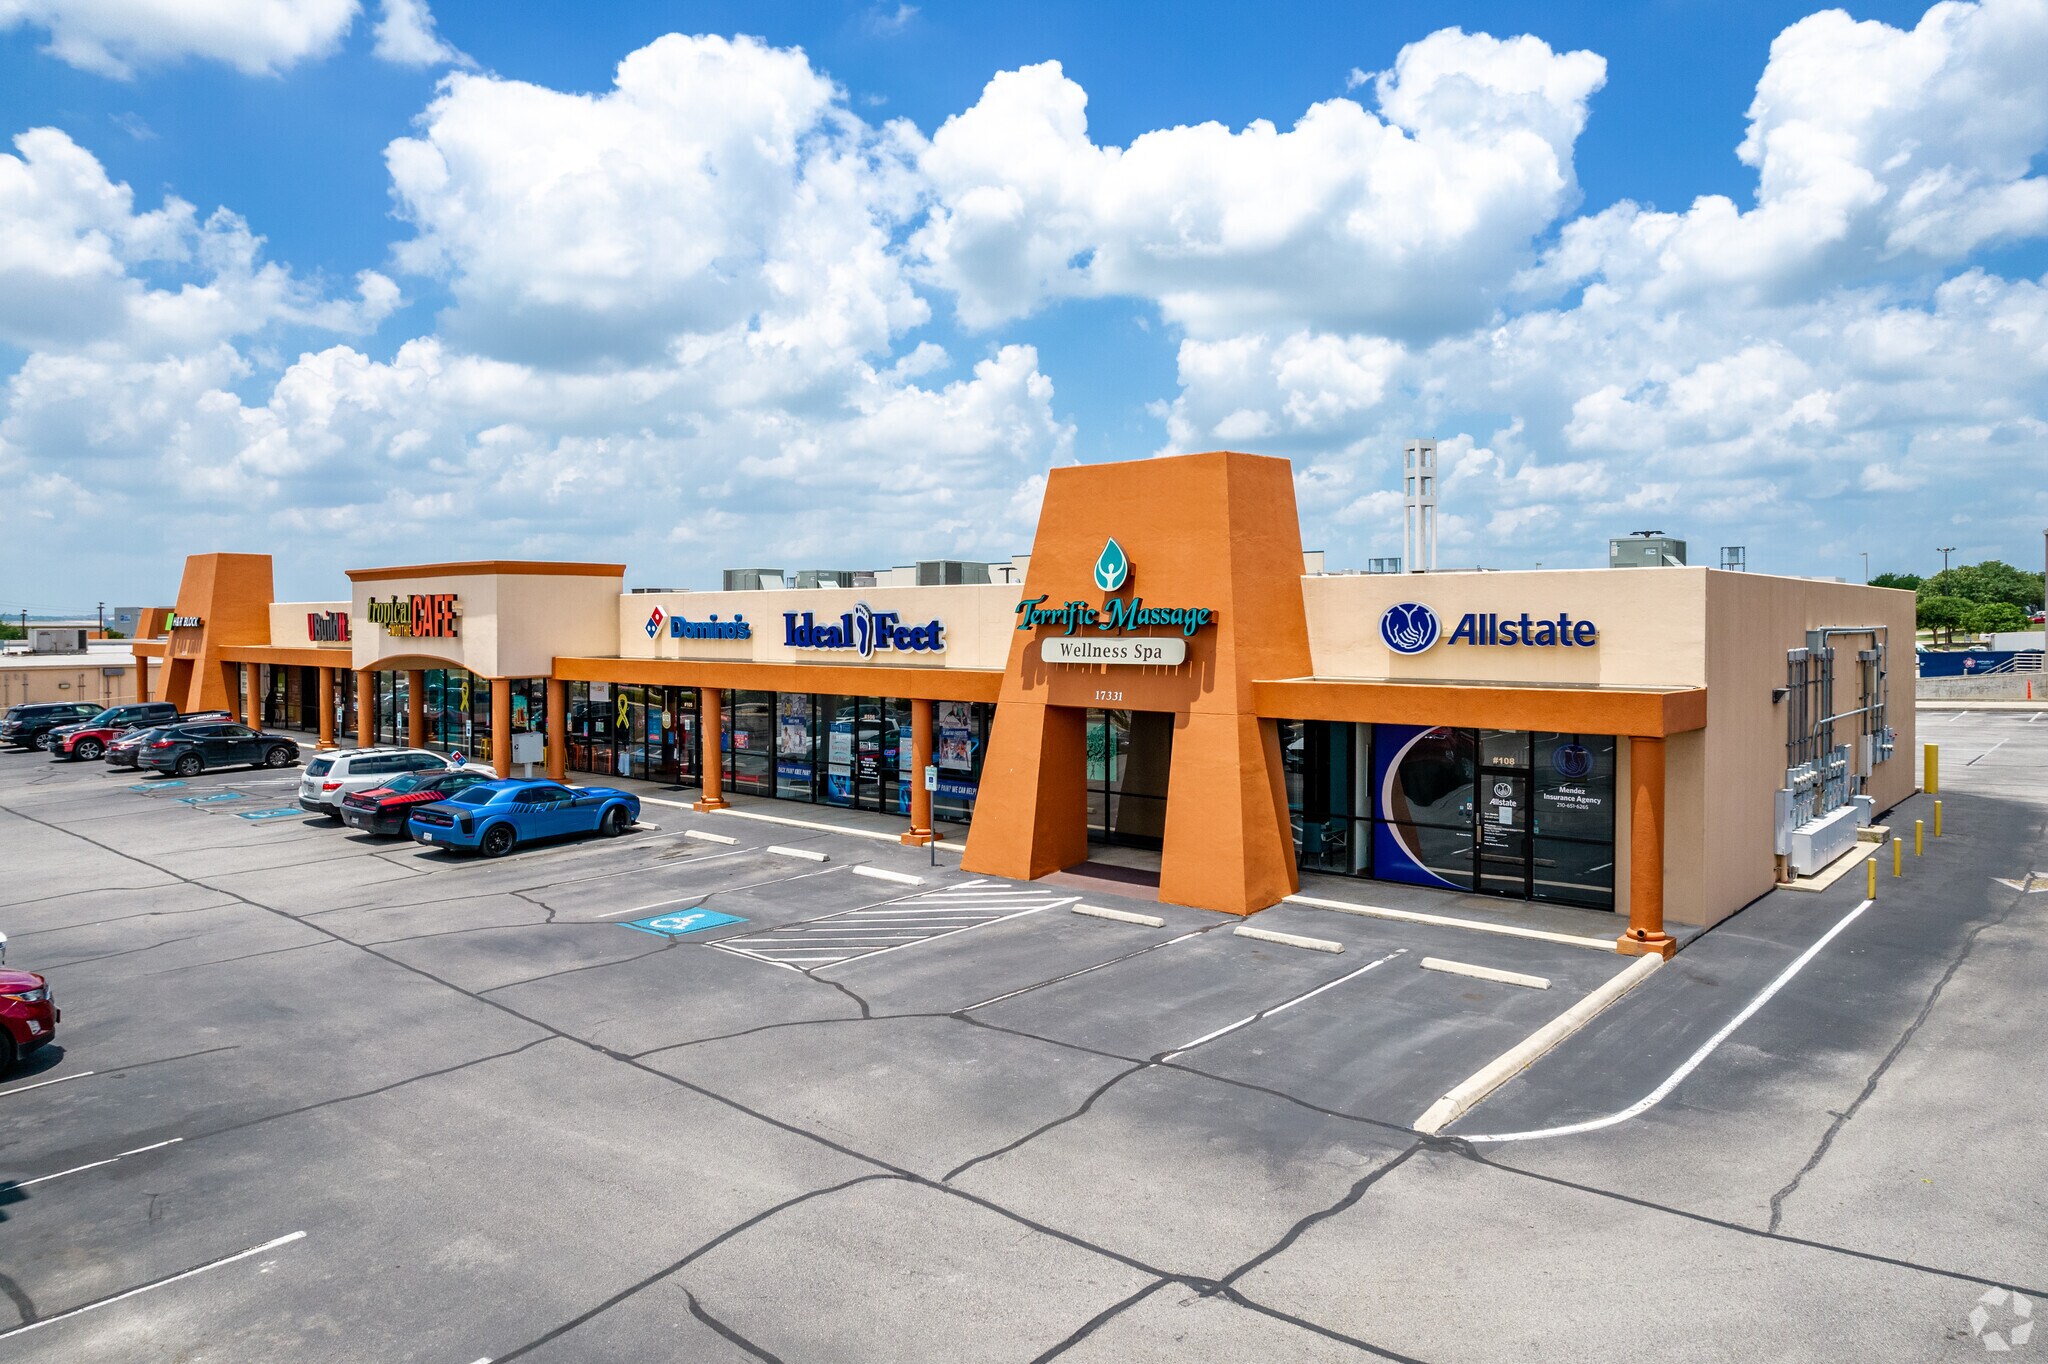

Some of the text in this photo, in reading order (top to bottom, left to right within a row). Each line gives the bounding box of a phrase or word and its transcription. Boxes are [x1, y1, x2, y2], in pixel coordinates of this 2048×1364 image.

[367, 594, 456, 637] tropical CAFE
[1015, 594, 1211, 636] Terrific Massage
[670, 613, 751, 640] Domino's
[782, 611, 945, 650] Ideal Feet
[1447, 612, 1597, 647] Allstate
[1060, 642, 1163, 662] Wellness Spa
[1095, 690, 1123, 701] 17331
[1492, 757, 1515, 765] #108
[1543, 793, 1602, 805] Insurance Agency
[1559, 786, 1586, 795] Mendez
[1489, 798, 1517, 807] Allstate
